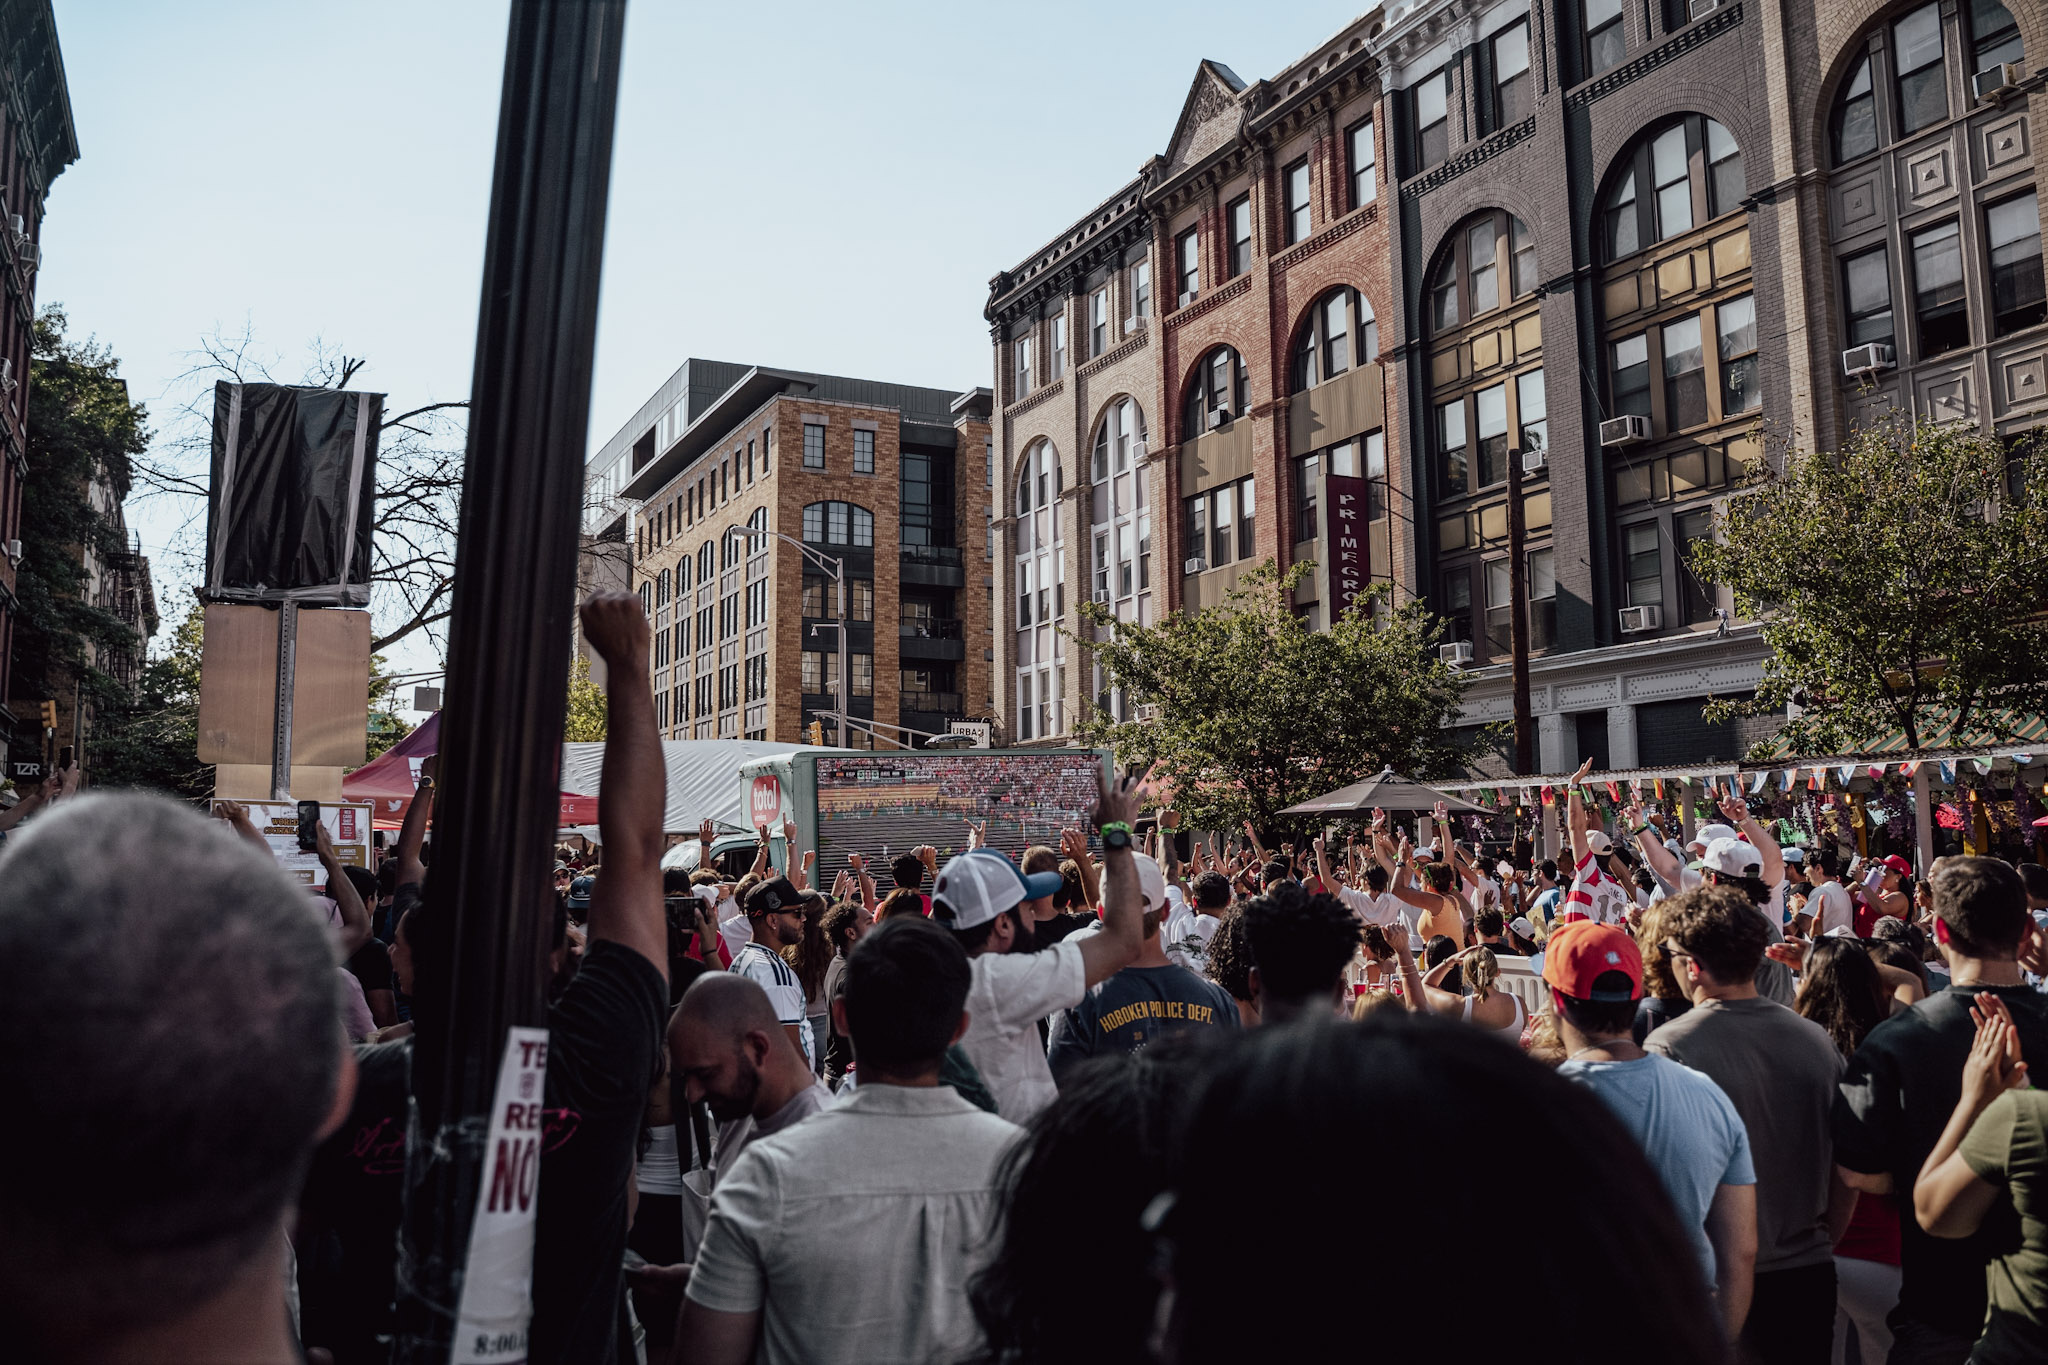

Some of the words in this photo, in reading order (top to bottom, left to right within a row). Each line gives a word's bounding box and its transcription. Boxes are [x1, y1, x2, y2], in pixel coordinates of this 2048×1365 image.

[13, 762, 40, 776] TZR
[1099, 1001, 1149, 1033] HOBOKEN
[1149, 1001, 1184, 1018] POLICE
[1187, 1003, 1213, 1025] DEPT.
